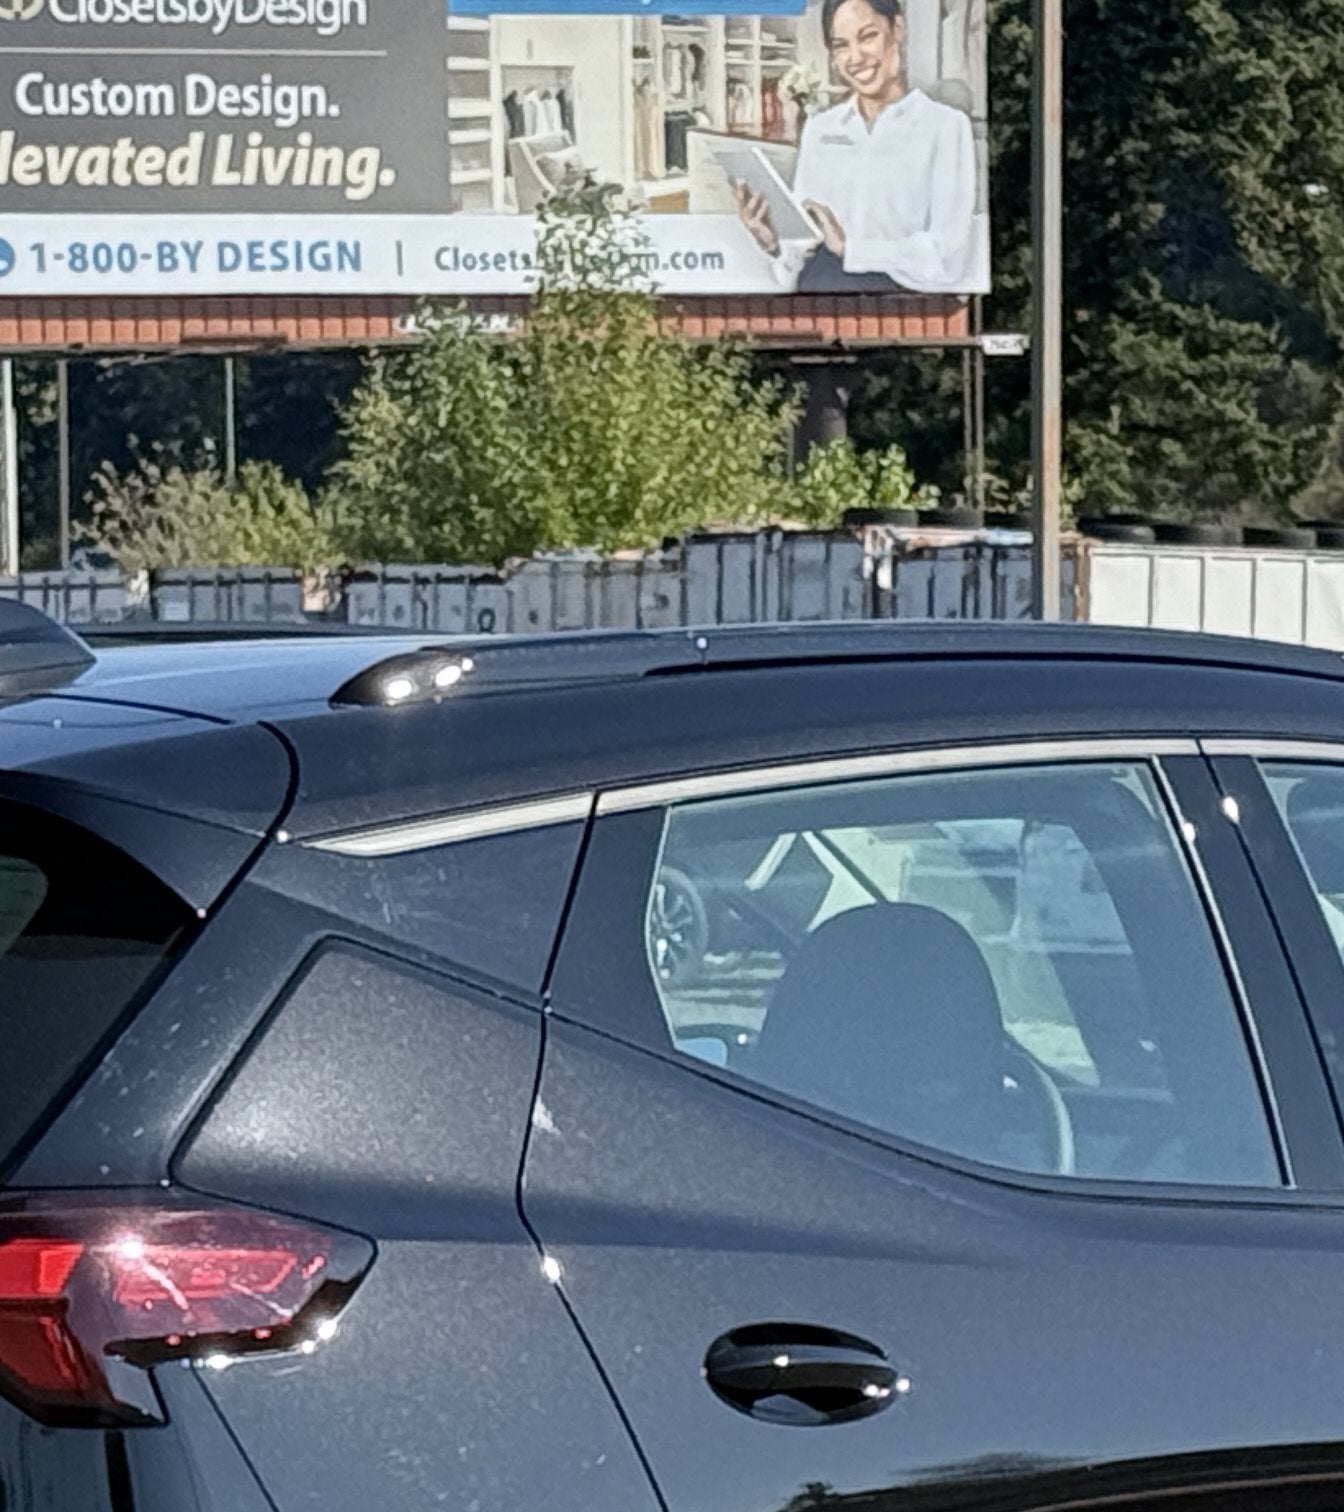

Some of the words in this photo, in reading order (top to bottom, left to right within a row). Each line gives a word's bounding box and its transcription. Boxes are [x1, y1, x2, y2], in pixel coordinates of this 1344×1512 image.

[49, 0, 366, 35] ClosetsbyDesign
[15, 72, 174, 116] Custom
[185, 73, 340, 128] Design.
[212, 132, 395, 199] Living.
[28, 241, 204, 273] 1-800-BY
[217, 241, 362, 273] DESIGN
